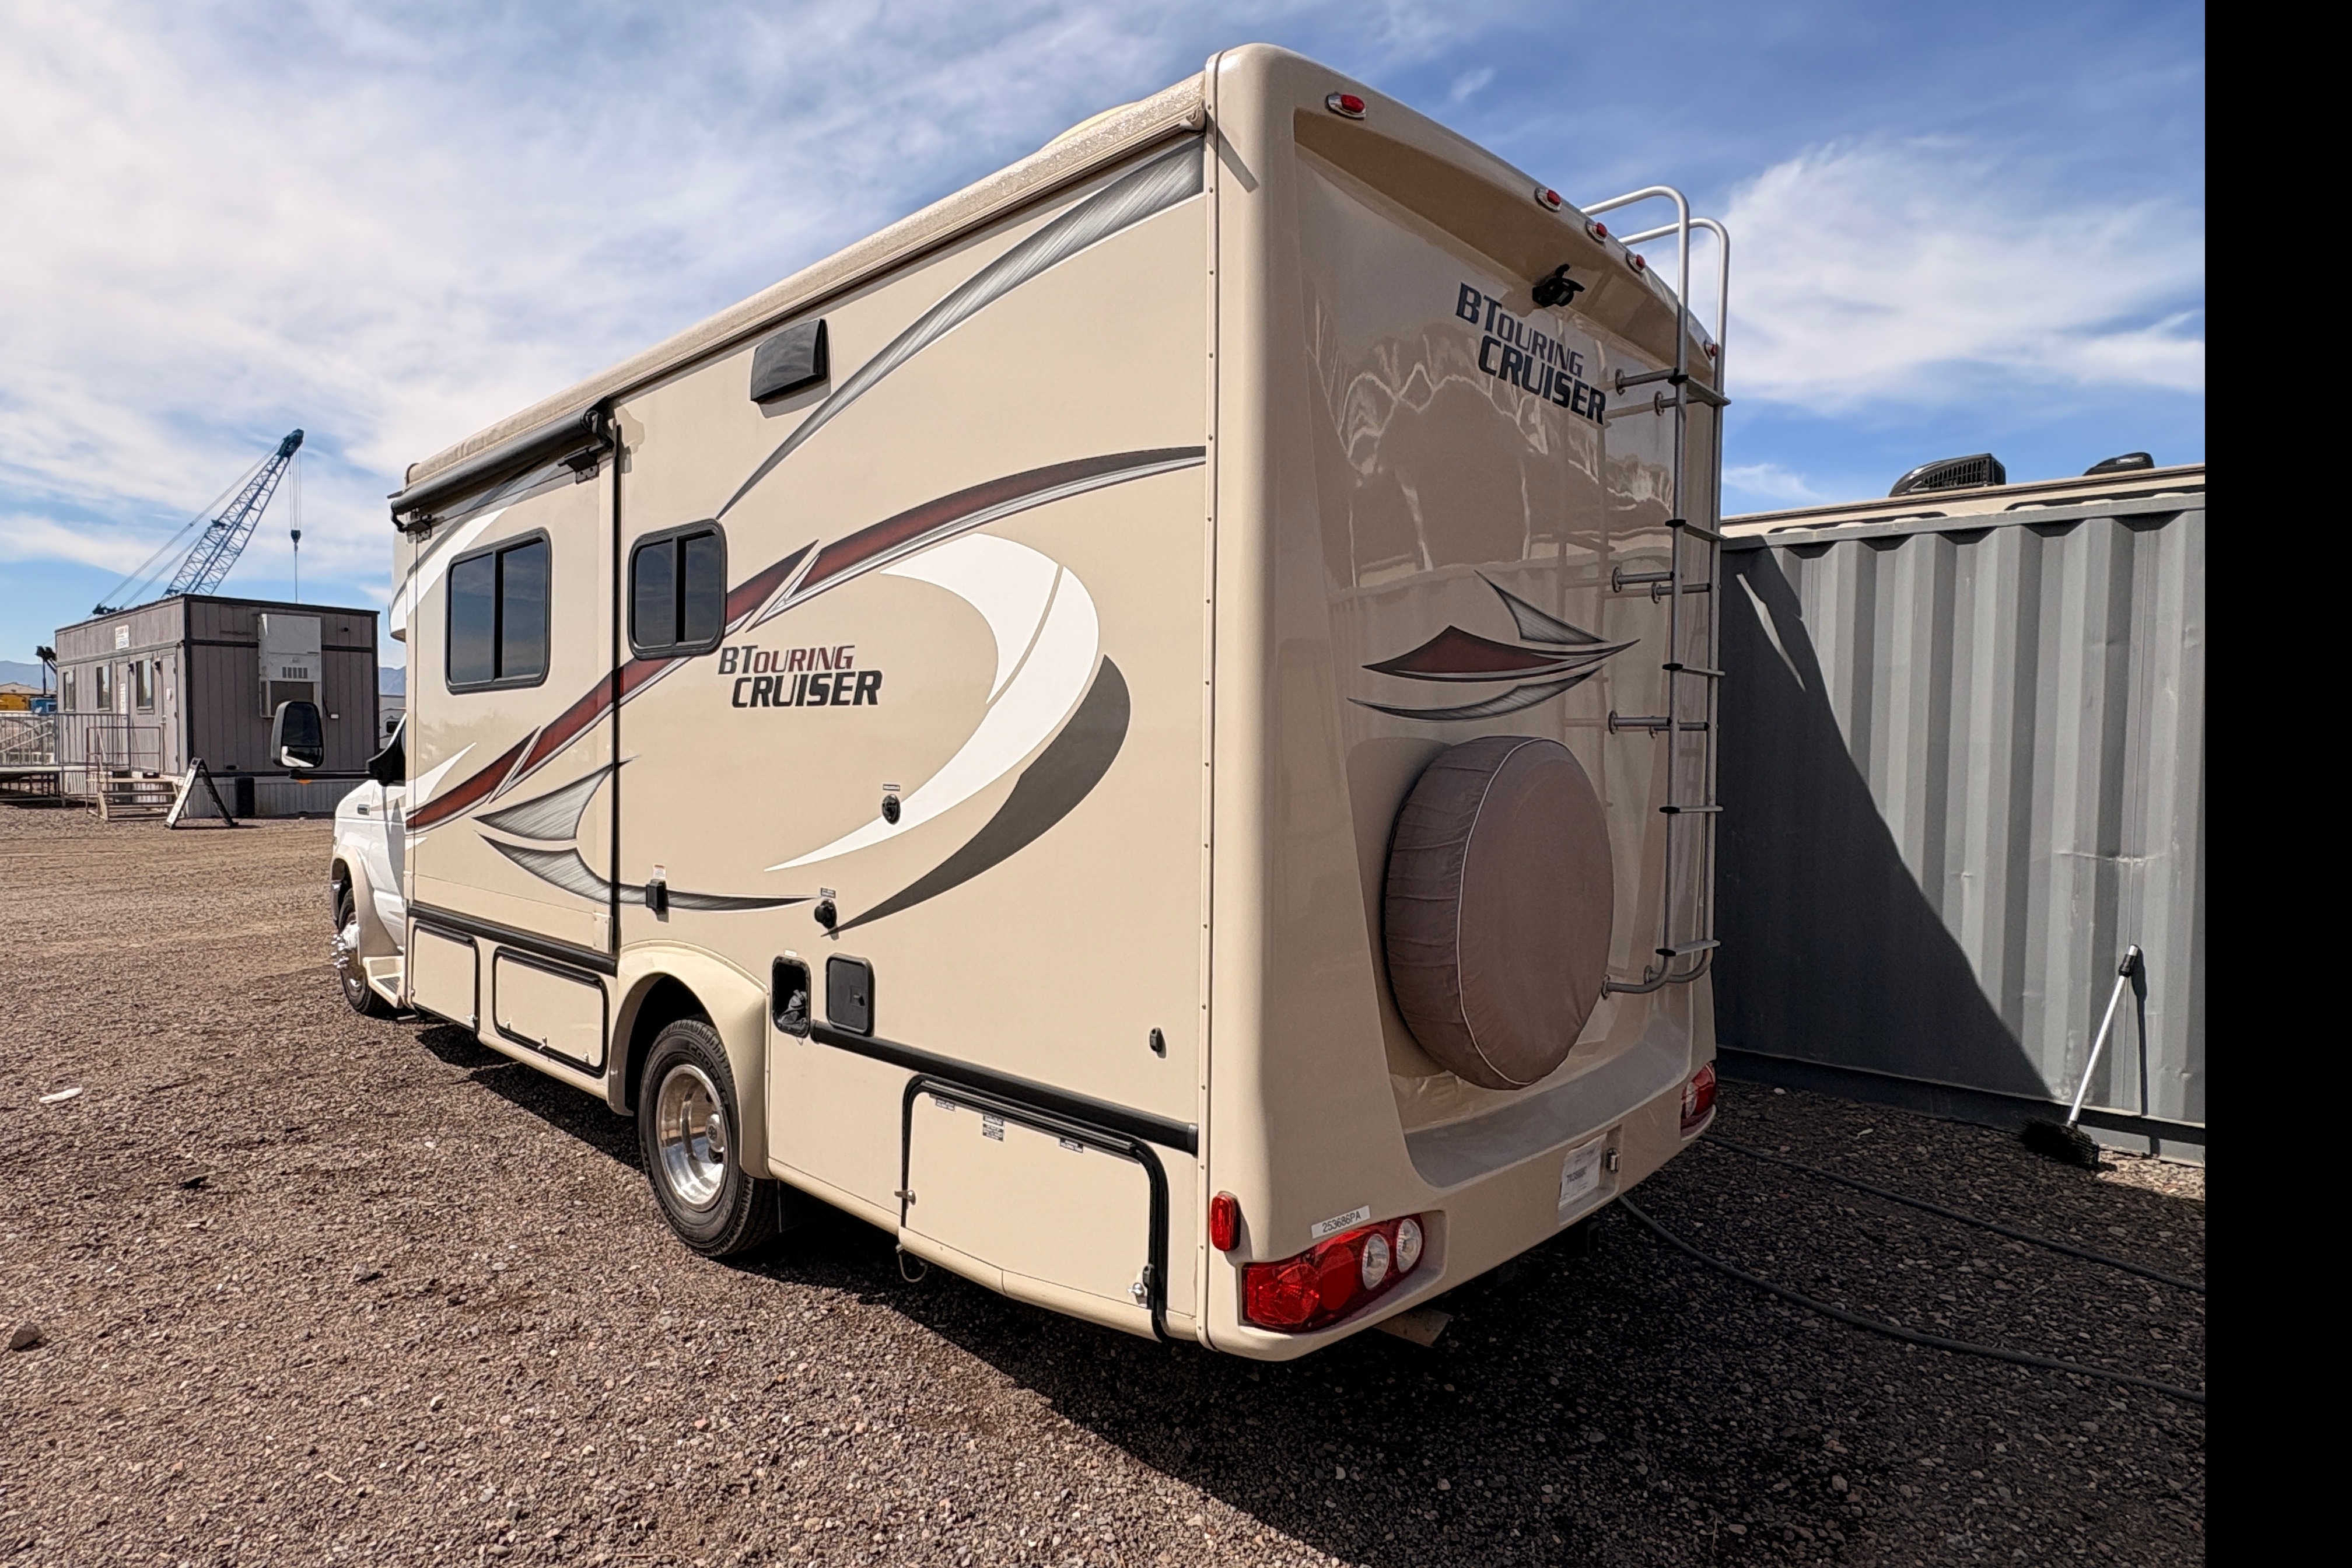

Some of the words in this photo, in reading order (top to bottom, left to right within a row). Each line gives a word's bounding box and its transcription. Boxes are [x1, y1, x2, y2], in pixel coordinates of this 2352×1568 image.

[1455, 282, 1584, 378] BTOURING
[1478, 335, 1606, 425] CRUISER
[718, 645, 855, 675] BTOURING
[732, 670, 883, 708] CRUISER
